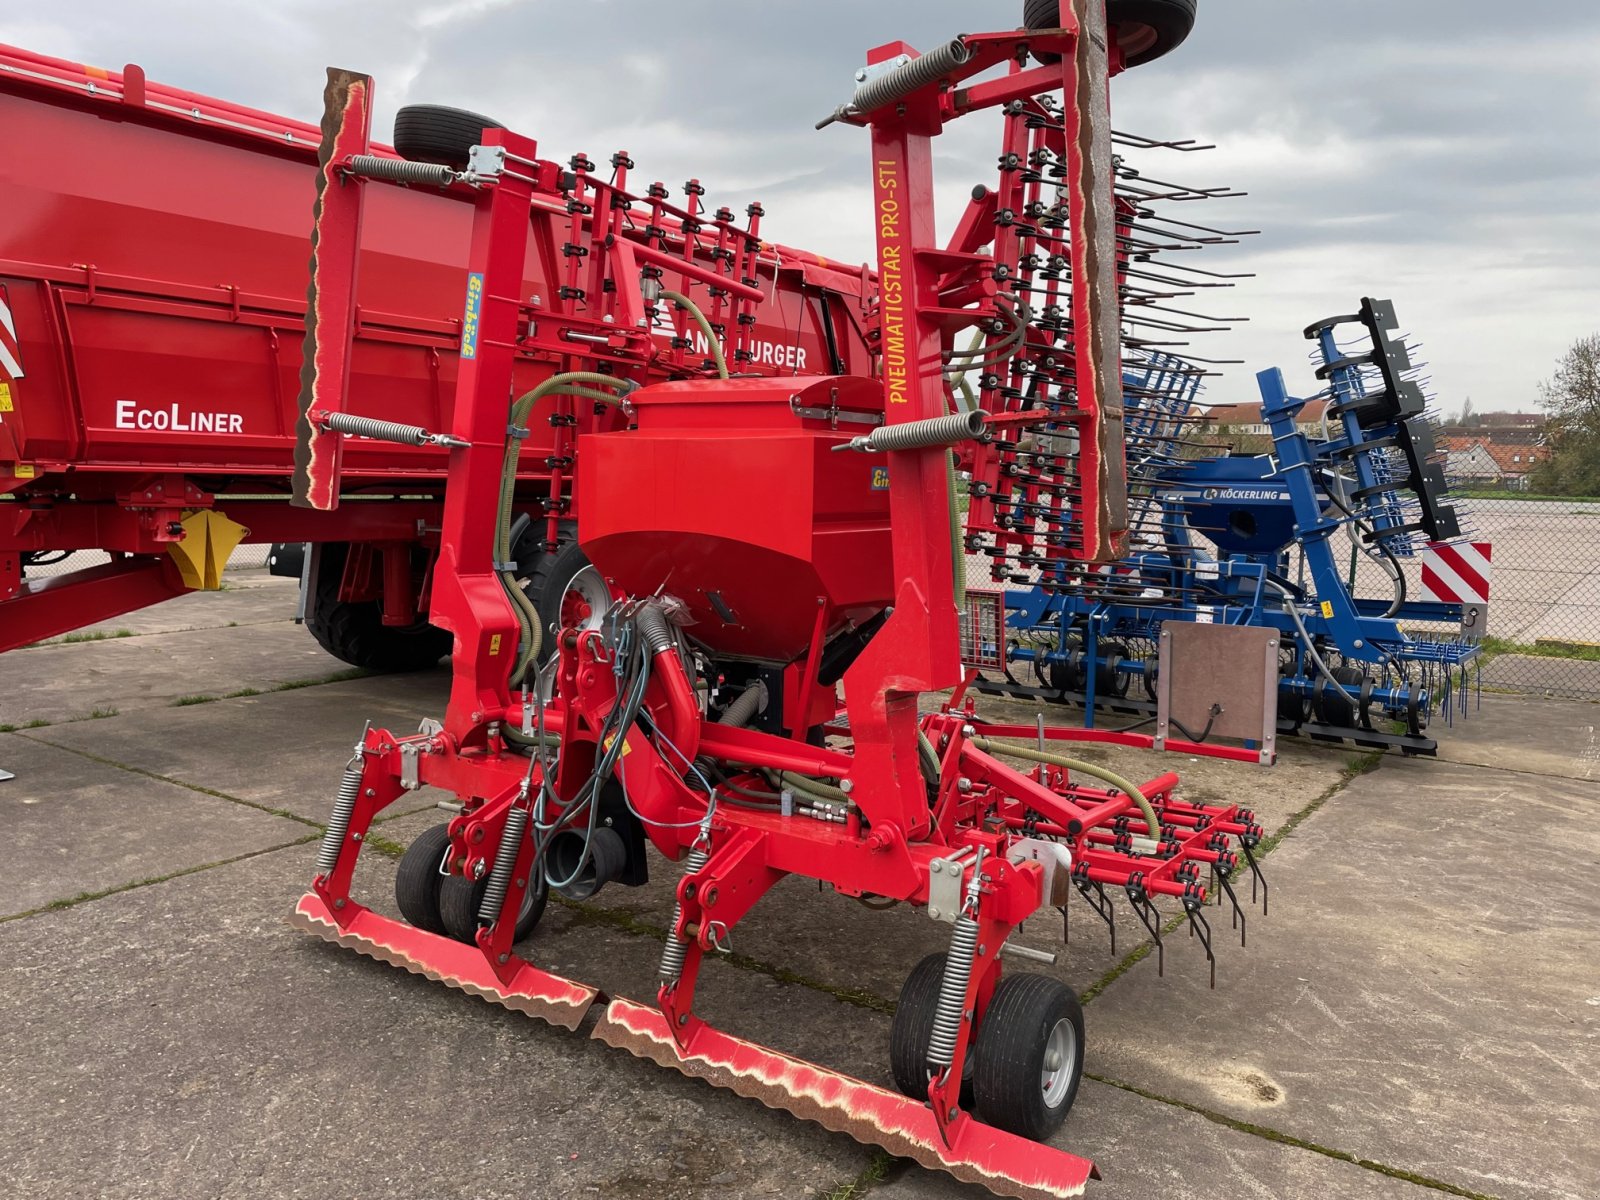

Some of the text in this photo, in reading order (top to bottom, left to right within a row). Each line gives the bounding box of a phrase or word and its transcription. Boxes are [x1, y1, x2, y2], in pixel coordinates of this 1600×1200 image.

[878, 160, 908, 404] PNEUMATICSTAR PRO-STI
[1219, 488, 1278, 500] KÖCKERLING
